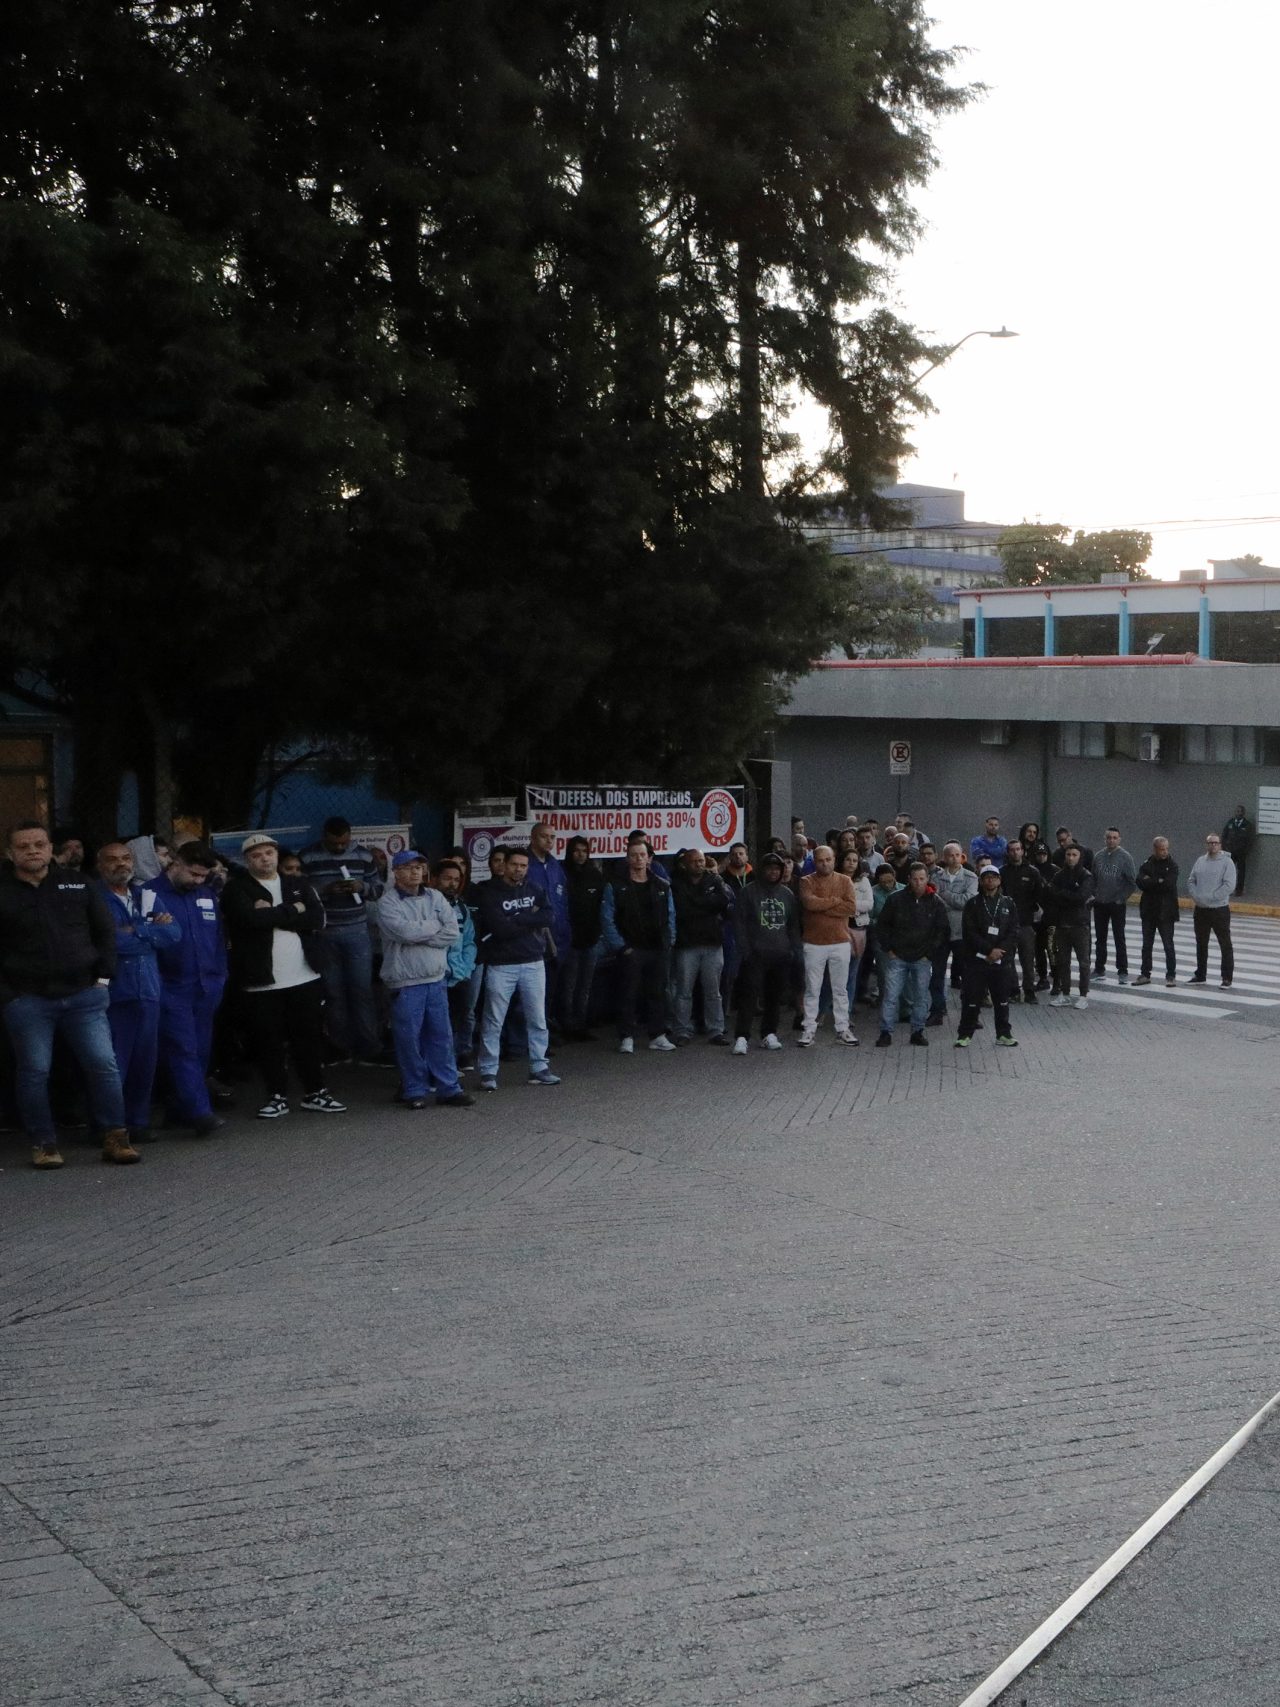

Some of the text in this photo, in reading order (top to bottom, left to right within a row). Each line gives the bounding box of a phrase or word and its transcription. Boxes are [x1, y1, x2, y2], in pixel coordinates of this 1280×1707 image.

[534, 790, 695, 808] EM DEFESA DOS EMPREGOS,
[636, 812, 661, 829] DOS
[666, 811, 696, 829] 30%
[502, 896, 535, 910] OAKLEY
